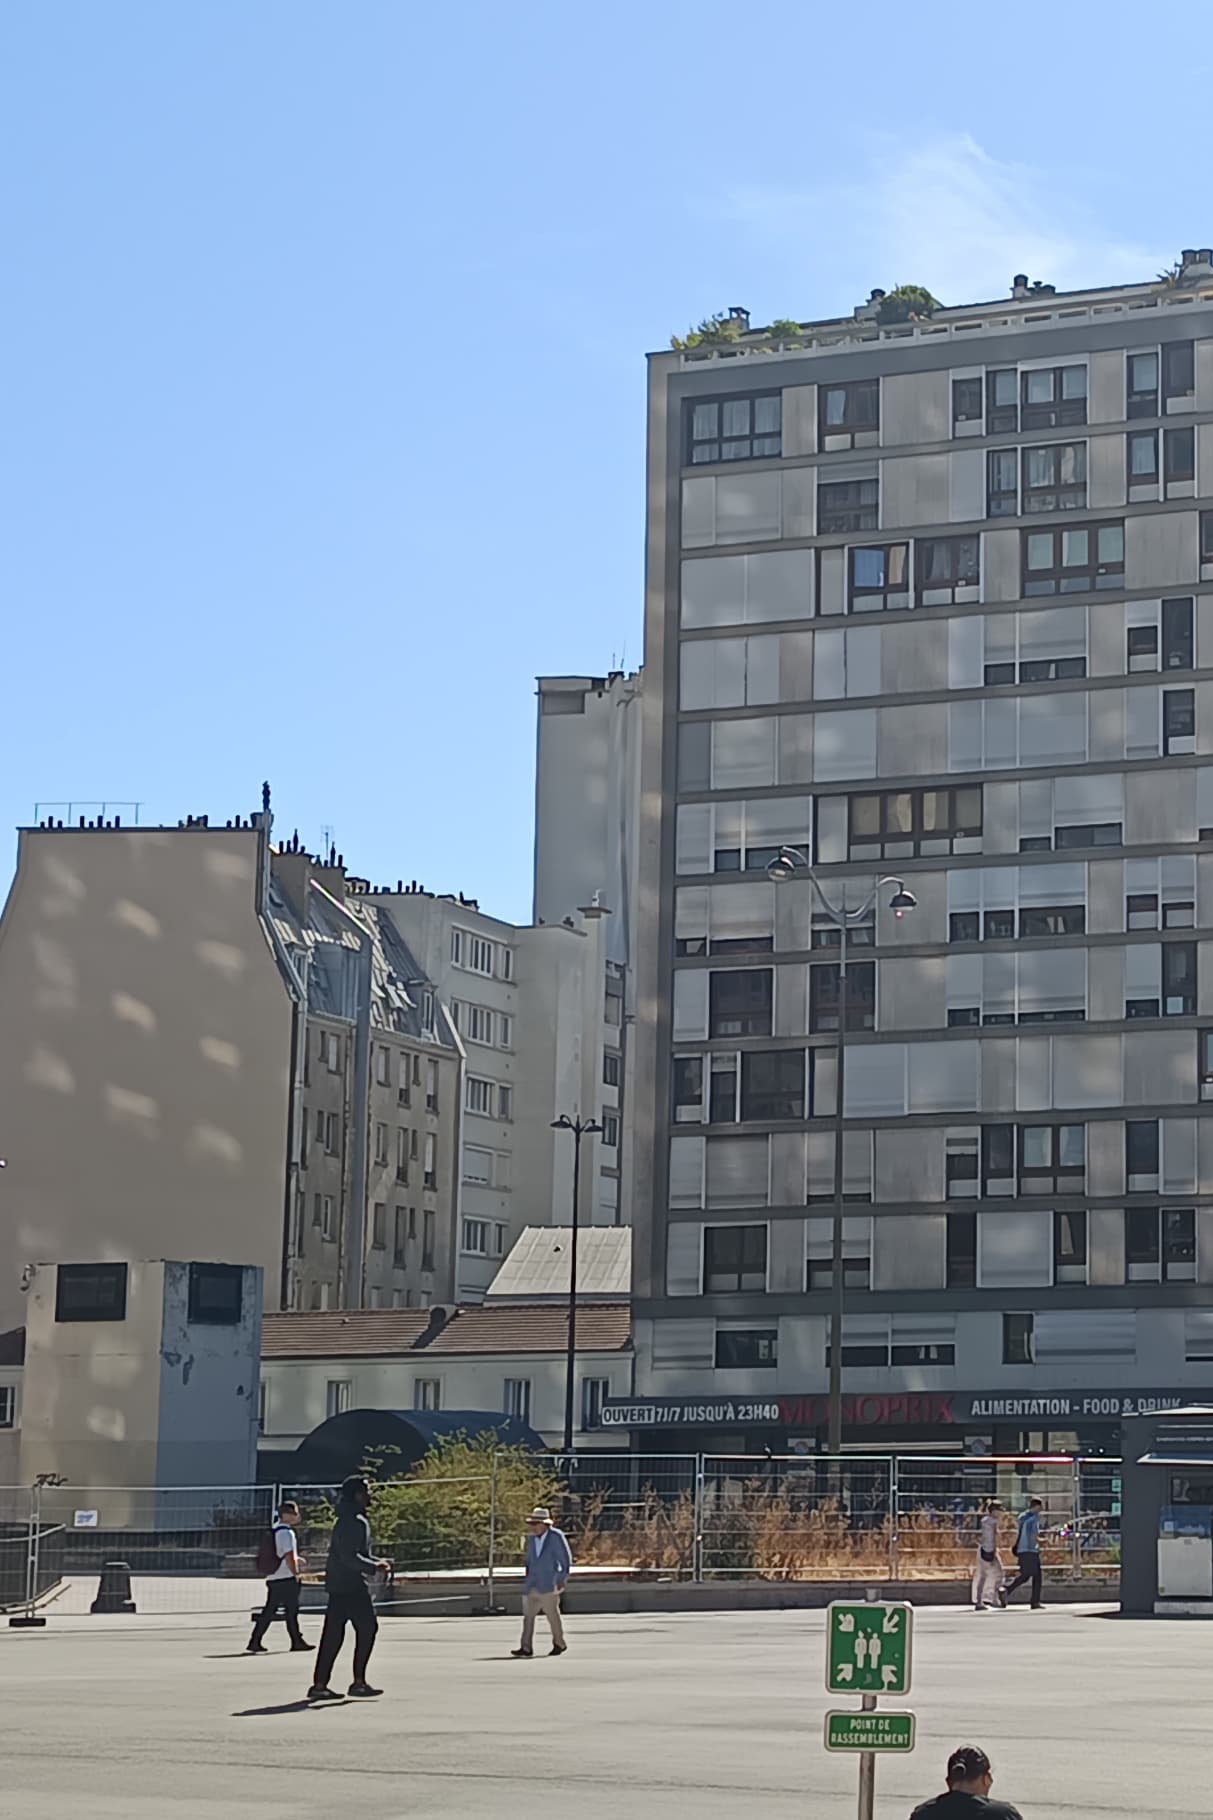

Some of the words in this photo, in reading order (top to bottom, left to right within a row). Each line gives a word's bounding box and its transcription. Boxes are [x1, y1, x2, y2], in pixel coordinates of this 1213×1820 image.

[603, 1407, 654, 1423] OUVERT
[656, 1406, 681, 1422] 7J/7
[682, 1402, 735, 1422] JUSQU'À
[737, 1404, 779, 1420] 23H40
[971, 1399, 1070, 1415] ALIMENTATION
[1083, 1398, 1120, 1414] FOOD
[1122, 1398, 1134, 1412] &
[850, 1719, 876, 1730] POINT
[878, 1719, 890, 1730] DE
[831, 1732, 908, 1745] RASSEMBLEMENT
